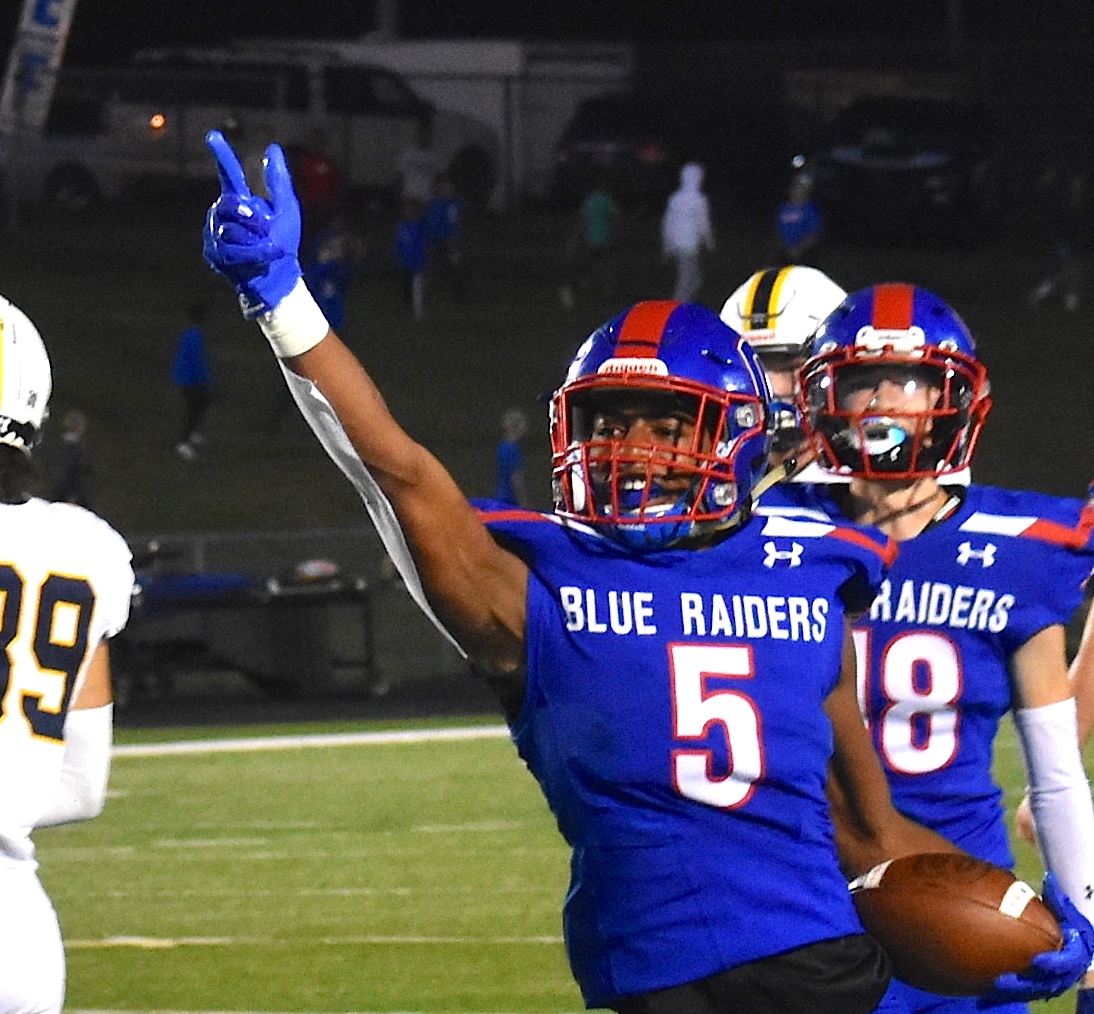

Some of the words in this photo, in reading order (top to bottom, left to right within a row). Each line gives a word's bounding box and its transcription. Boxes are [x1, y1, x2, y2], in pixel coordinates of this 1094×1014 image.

[560, 585, 657, 635] BLUE
[680, 592, 829, 642] RAIDERS
[870, 578, 1016, 633] RAIDERS
[667, 641, 767, 810] 5
